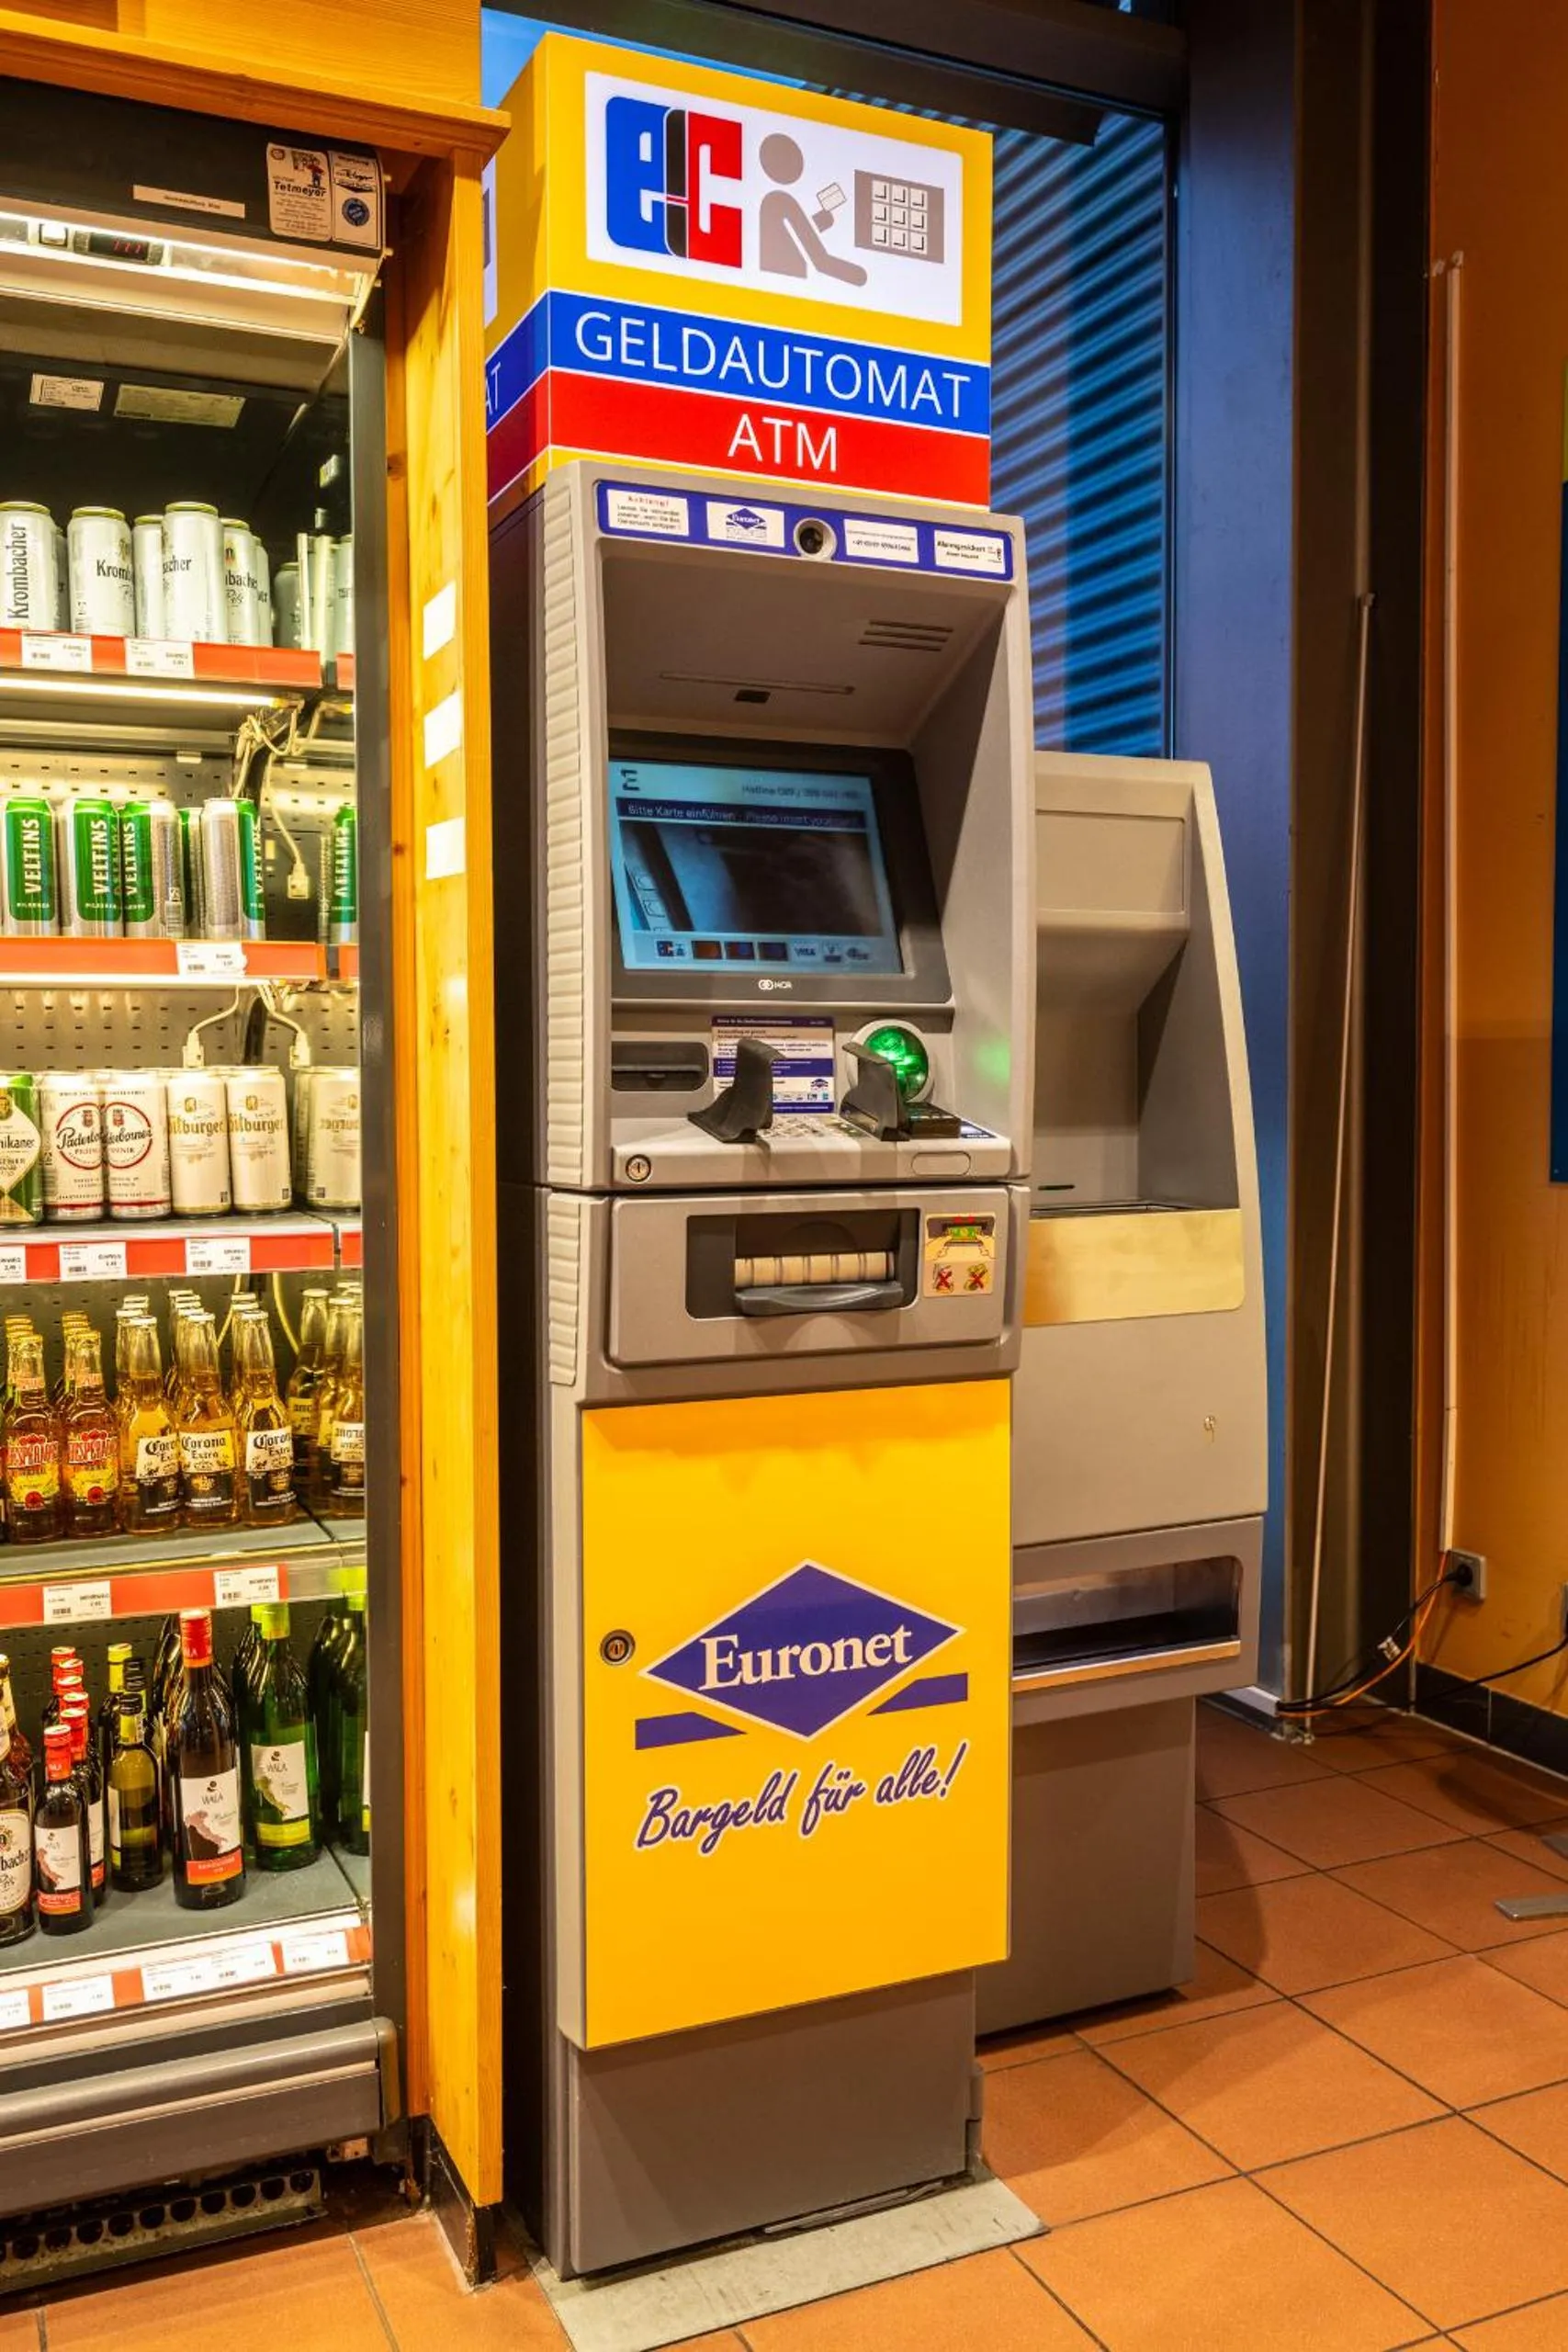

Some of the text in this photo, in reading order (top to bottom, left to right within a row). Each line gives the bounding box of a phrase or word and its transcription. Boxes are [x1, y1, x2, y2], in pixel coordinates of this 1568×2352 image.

[575, 311, 970, 418] GELDAUTOMAT
[728, 413, 838, 472] ATM
[6, 524, 29, 619] Krombacher
[628, 804, 653, 816] Bitte
[655, 806, 684, 818] Karte
[22, 819, 42, 894] VELTINS
[91, 820, 110, 896] VELTINS
[123, 821, 138, 896] VELTINS
[181, 1436, 226, 1453] Corona
[191, 1450, 219, 1459] Extra
[697, 1624, 914, 1691] Euronet
[636, 1741, 969, 1855] Bargeld für alle!
